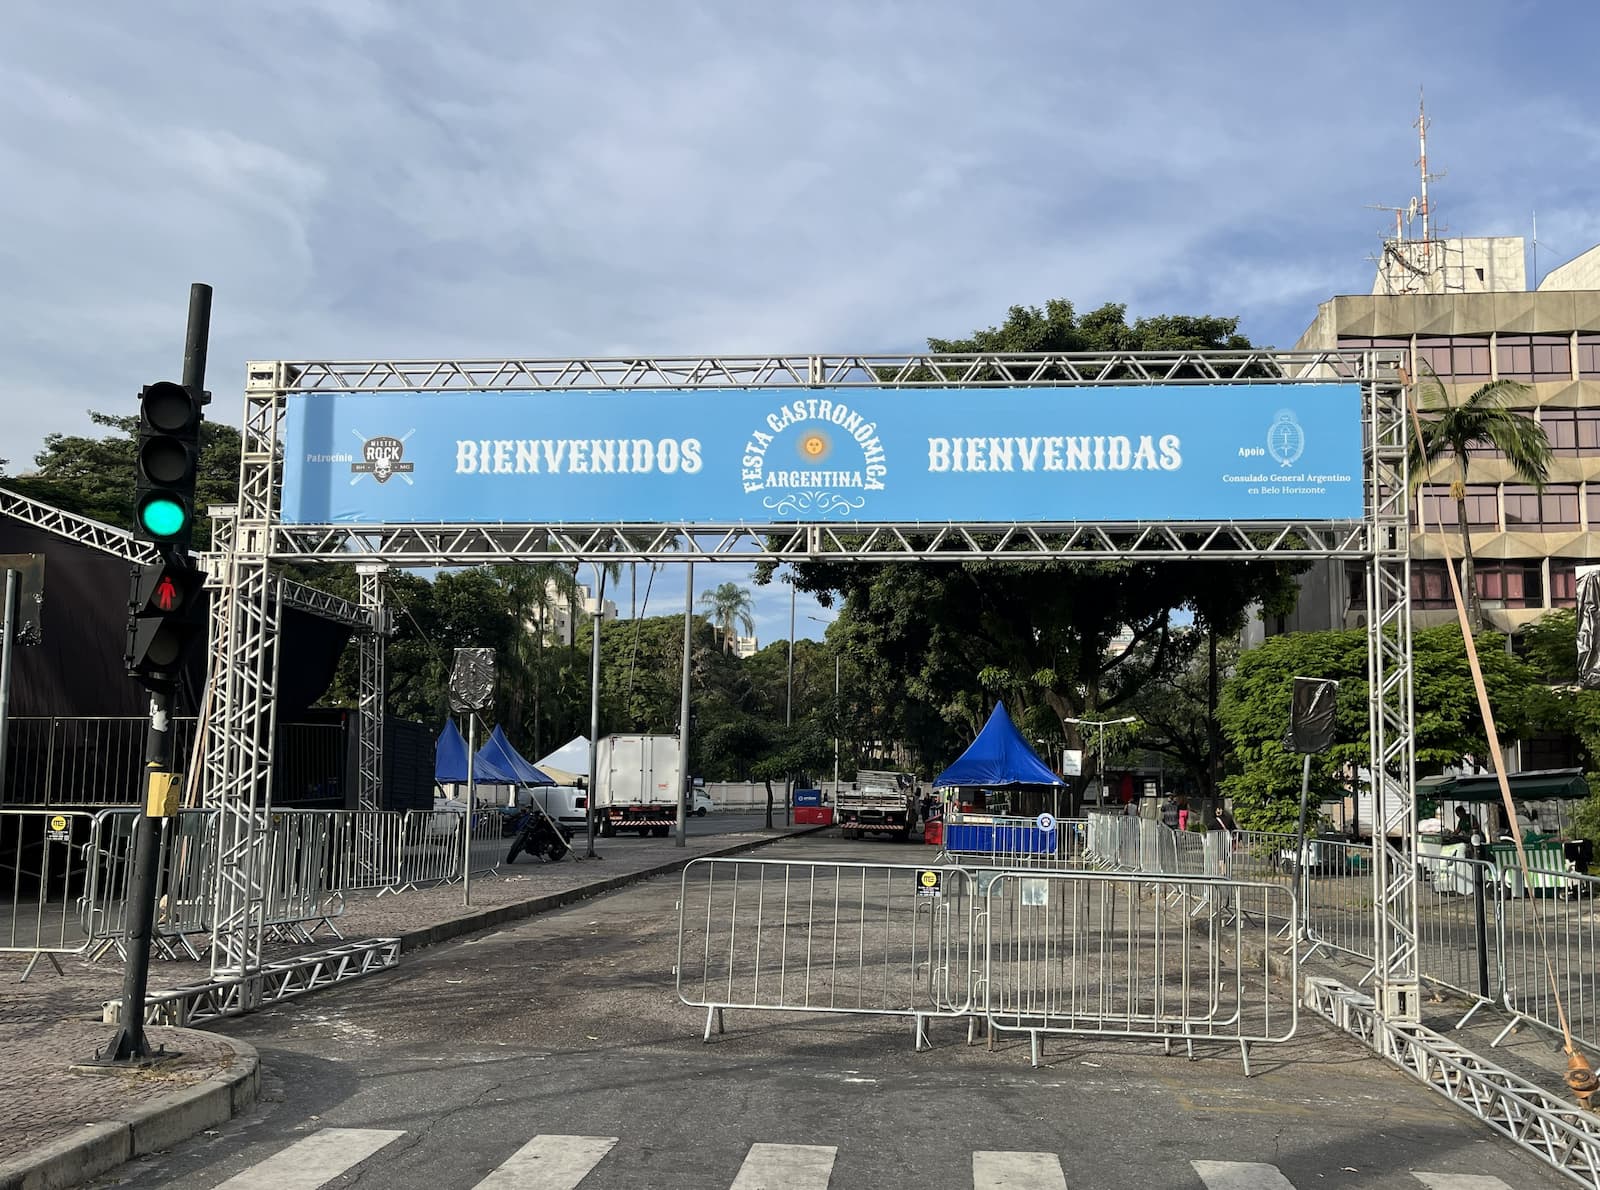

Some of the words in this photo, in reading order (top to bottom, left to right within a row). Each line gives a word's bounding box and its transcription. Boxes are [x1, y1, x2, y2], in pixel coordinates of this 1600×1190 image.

[366, 446, 400, 460] ROCK
[742, 430, 774, 494] FESTA
[766, 399, 887, 491] GASTRONÔMICA
[928, 434, 1183, 473] BIENVENIDAS
[1238, 446, 1265, 457] Apoio
[455, 438, 702, 475] BIENVENIDOS
[766, 472, 863, 488] ARGENTINA
[1222, 474, 1268, 483] Consulado
[1270, 474, 1305, 483] General
[1307, 474, 1351, 484] Argentino
[1248, 487, 1259, 495] en
[1261, 486, 1280, 495] Belo
[1282, 486, 1326, 495] Horizonte
